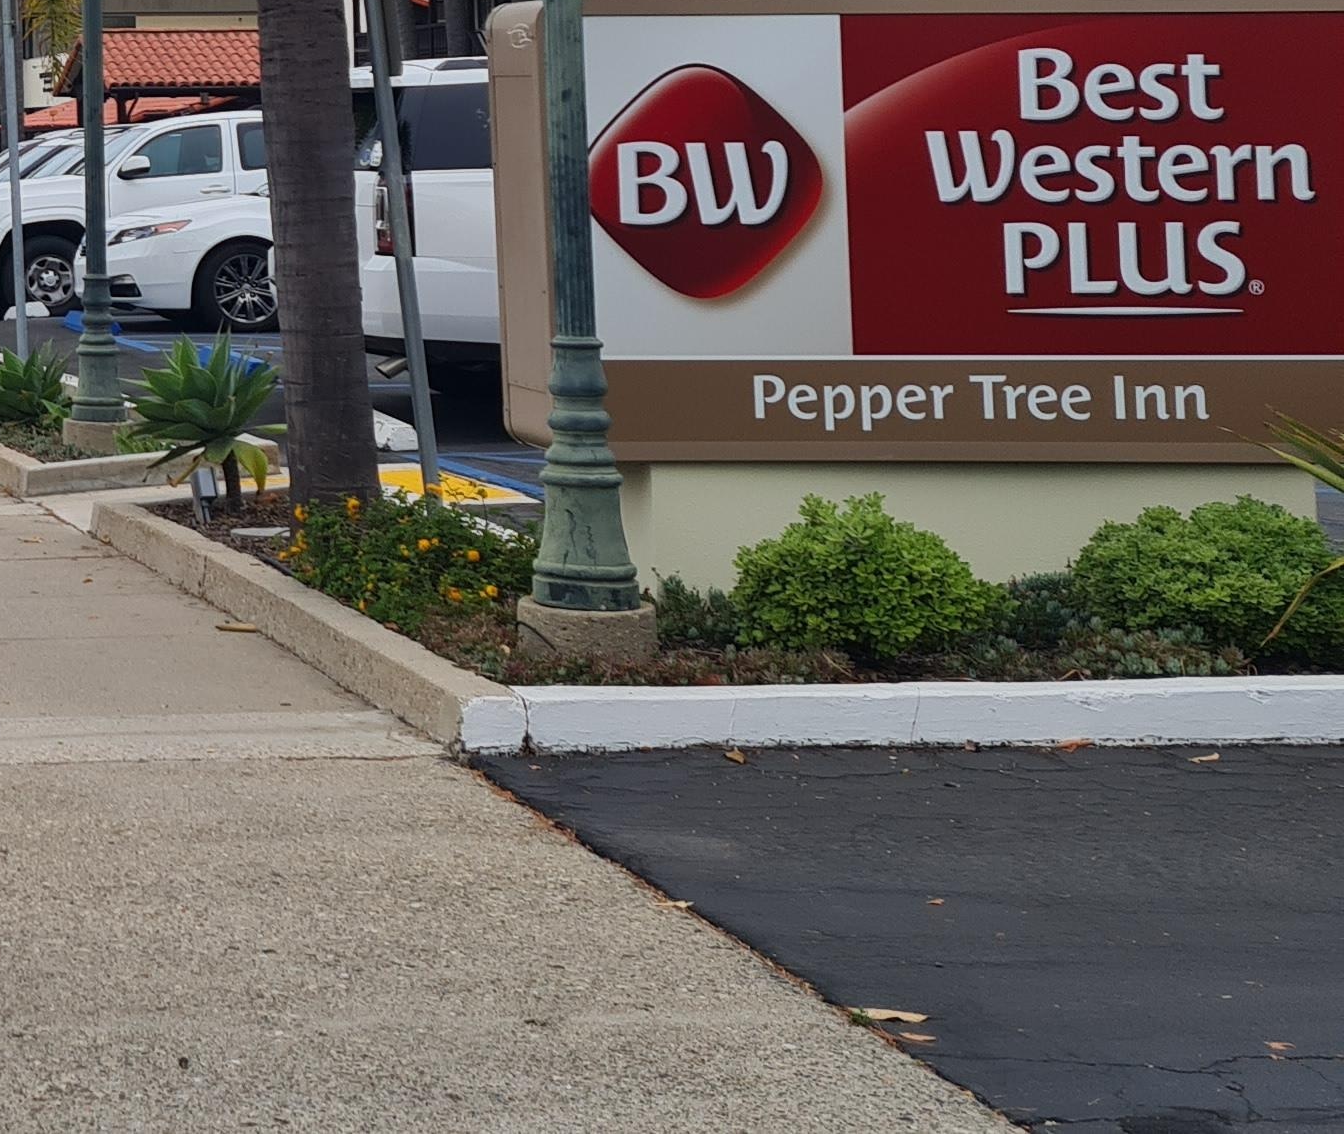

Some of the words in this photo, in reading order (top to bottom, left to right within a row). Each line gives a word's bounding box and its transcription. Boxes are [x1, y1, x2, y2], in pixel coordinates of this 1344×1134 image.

[1018, 48, 1223, 121] Best
[617, 141, 788, 226] BW
[925, 130, 1315, 203] Western
[754, 375, 954, 431] Pepper
[970, 375, 1091, 420] Tree
[1114, 375, 1210, 420] Inn
